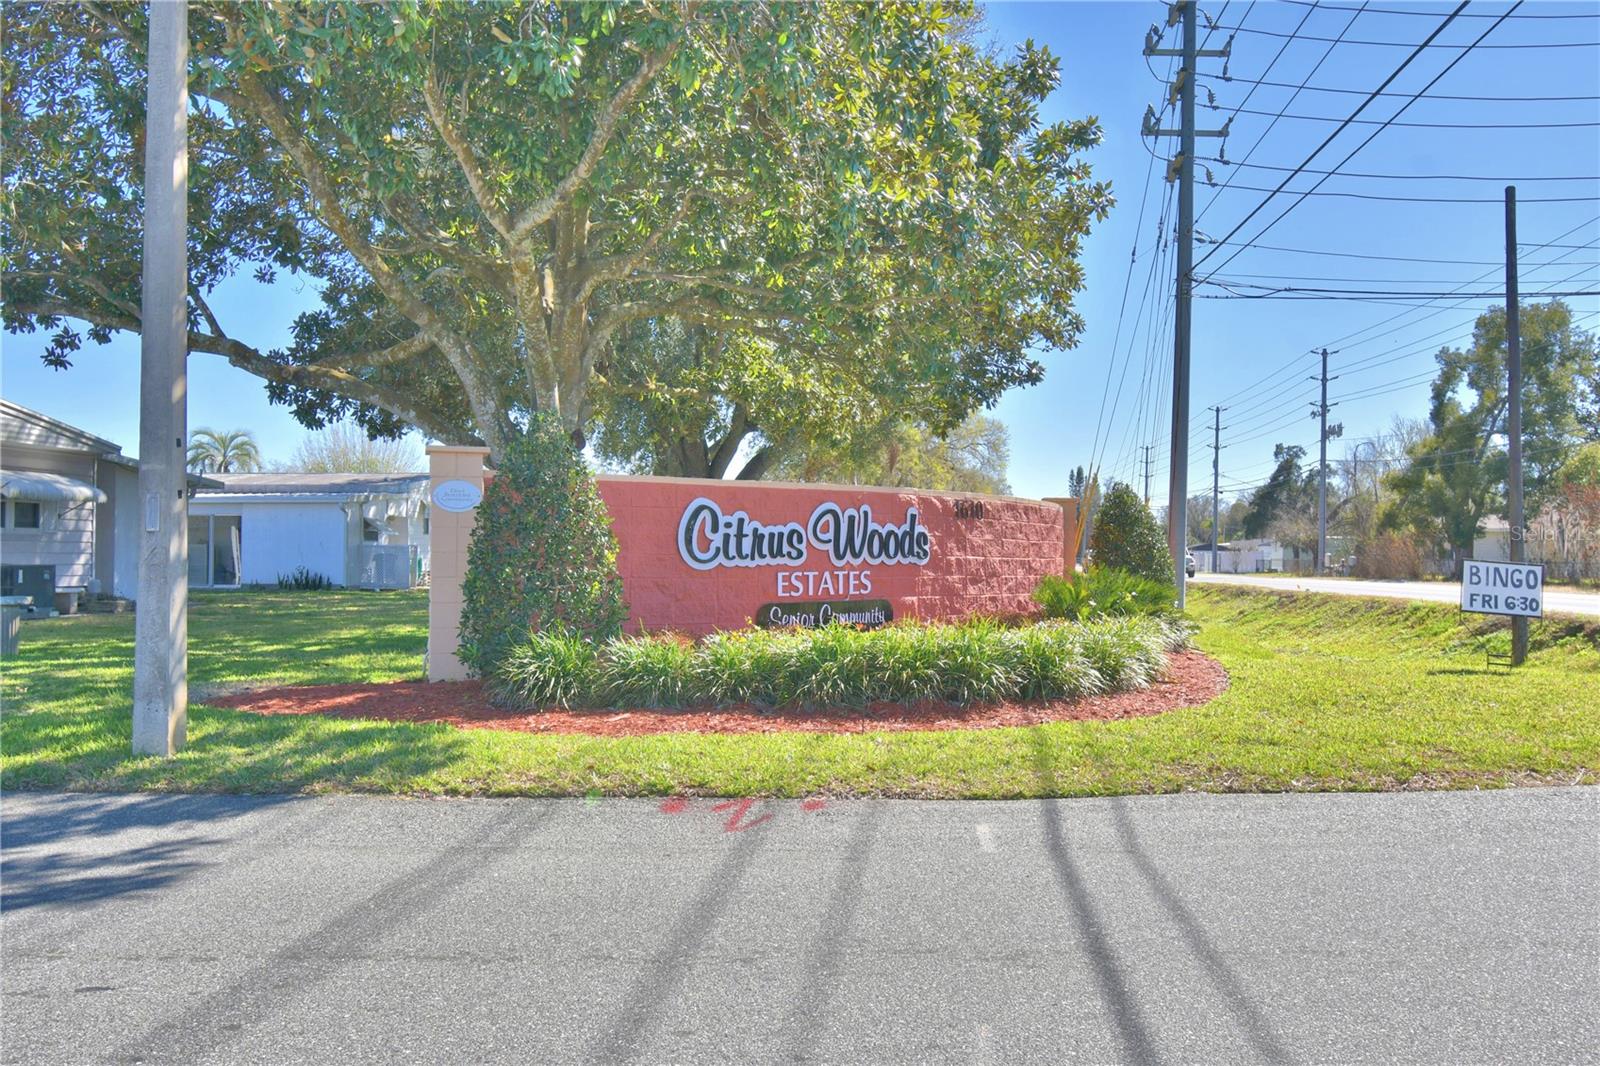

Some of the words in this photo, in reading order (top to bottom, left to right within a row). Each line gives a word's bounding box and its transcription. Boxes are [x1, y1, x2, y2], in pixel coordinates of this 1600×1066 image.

[683, 503, 805, 565] Citrus
[811, 507, 929, 564] Woods
[777, 571, 872, 597] ESTATES
[1469, 565, 1539, 590] BINGO
[1469, 593, 1498, 610] FRI
[1504, 596, 1540, 612] 6:30
[770, 606, 815, 627] Senior
